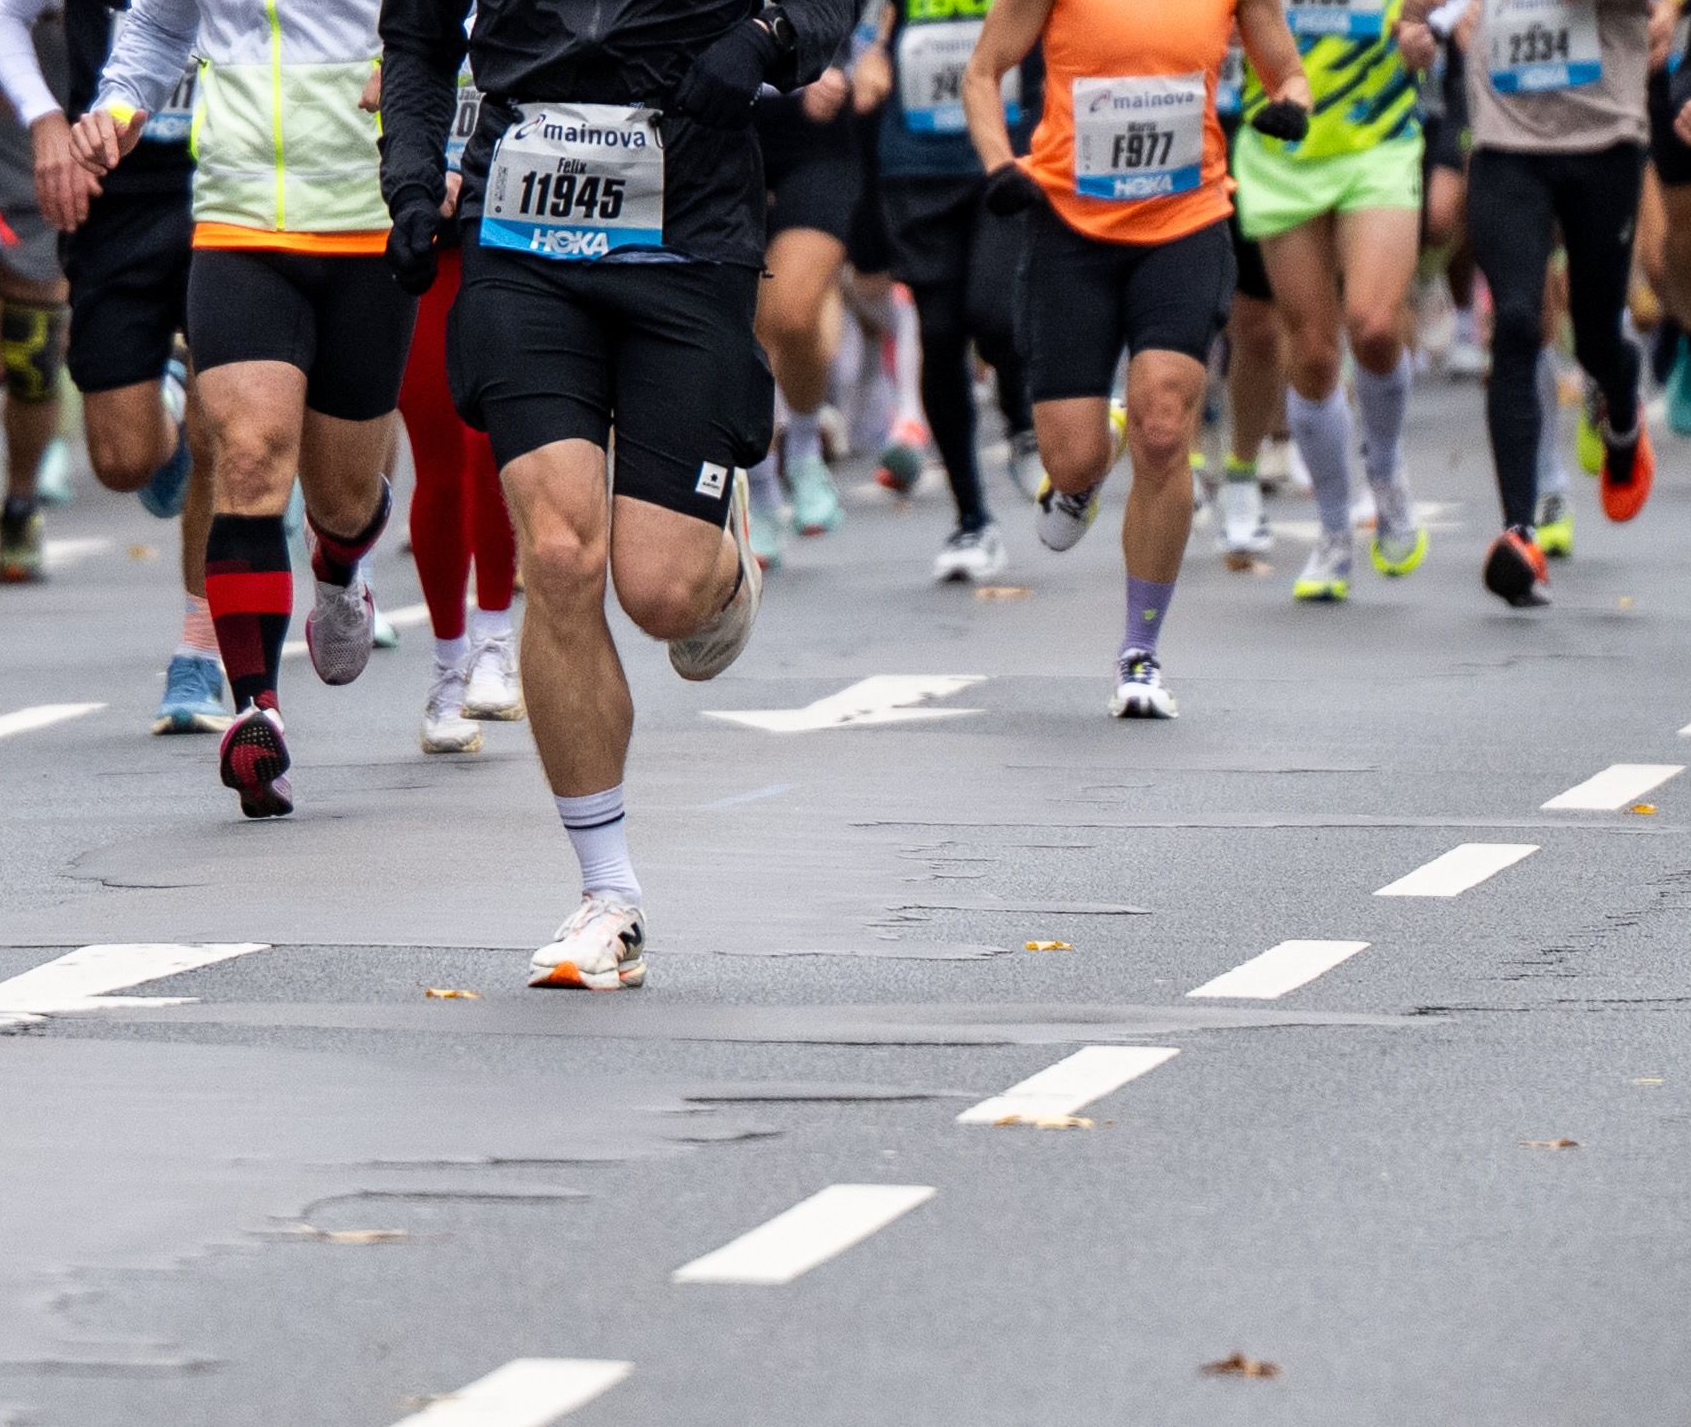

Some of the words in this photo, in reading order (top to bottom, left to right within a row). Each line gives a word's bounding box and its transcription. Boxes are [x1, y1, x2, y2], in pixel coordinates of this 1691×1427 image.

[1113, 91, 1195, 110] mainova
[543, 123, 647, 148] mainova
[1111, 130, 1175, 169] F977
[557, 157, 587, 174] Felix
[519, 171, 626, 219] 11945
[530, 228, 610, 256] HOKA
